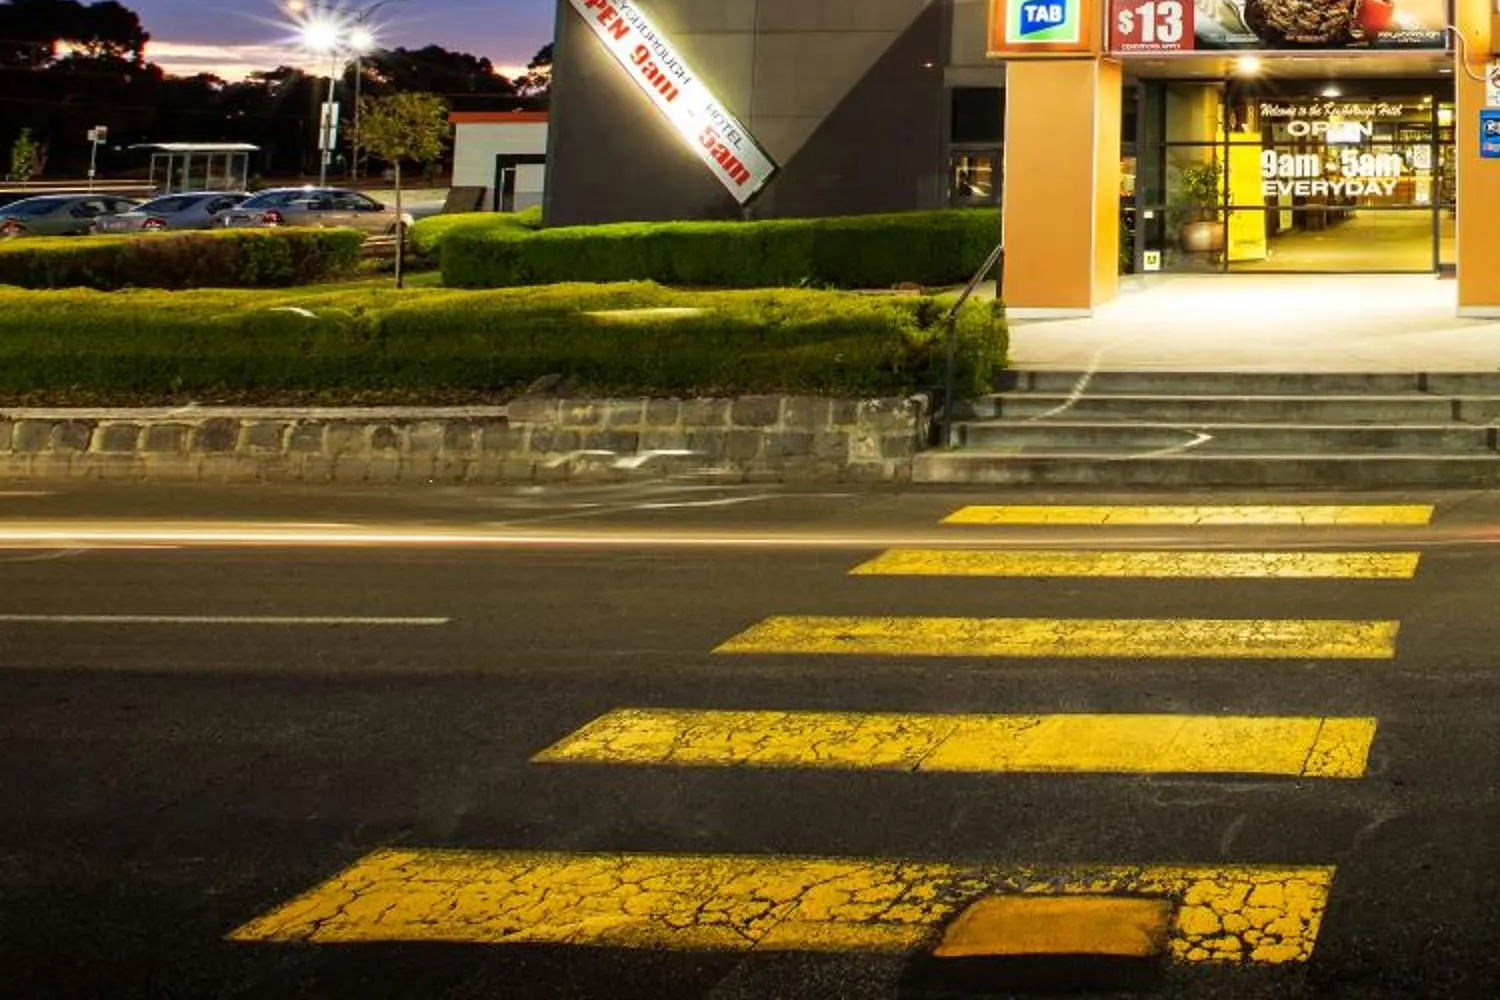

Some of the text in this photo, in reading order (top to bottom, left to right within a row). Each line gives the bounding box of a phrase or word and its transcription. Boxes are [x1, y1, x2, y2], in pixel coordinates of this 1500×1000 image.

[1024, 5, 1062, 23] TAB
[1118, 1, 1183, 43] $13
[629, 44, 680, 103] 9am
[698, 125, 751, 186] 5am
[705, 103, 746, 151] HOTEL
[1288, 120, 1373, 137] OPN
[1263, 149, 1320, 178] 9am
[1264, 180, 1398, 197] EVERYDAY
